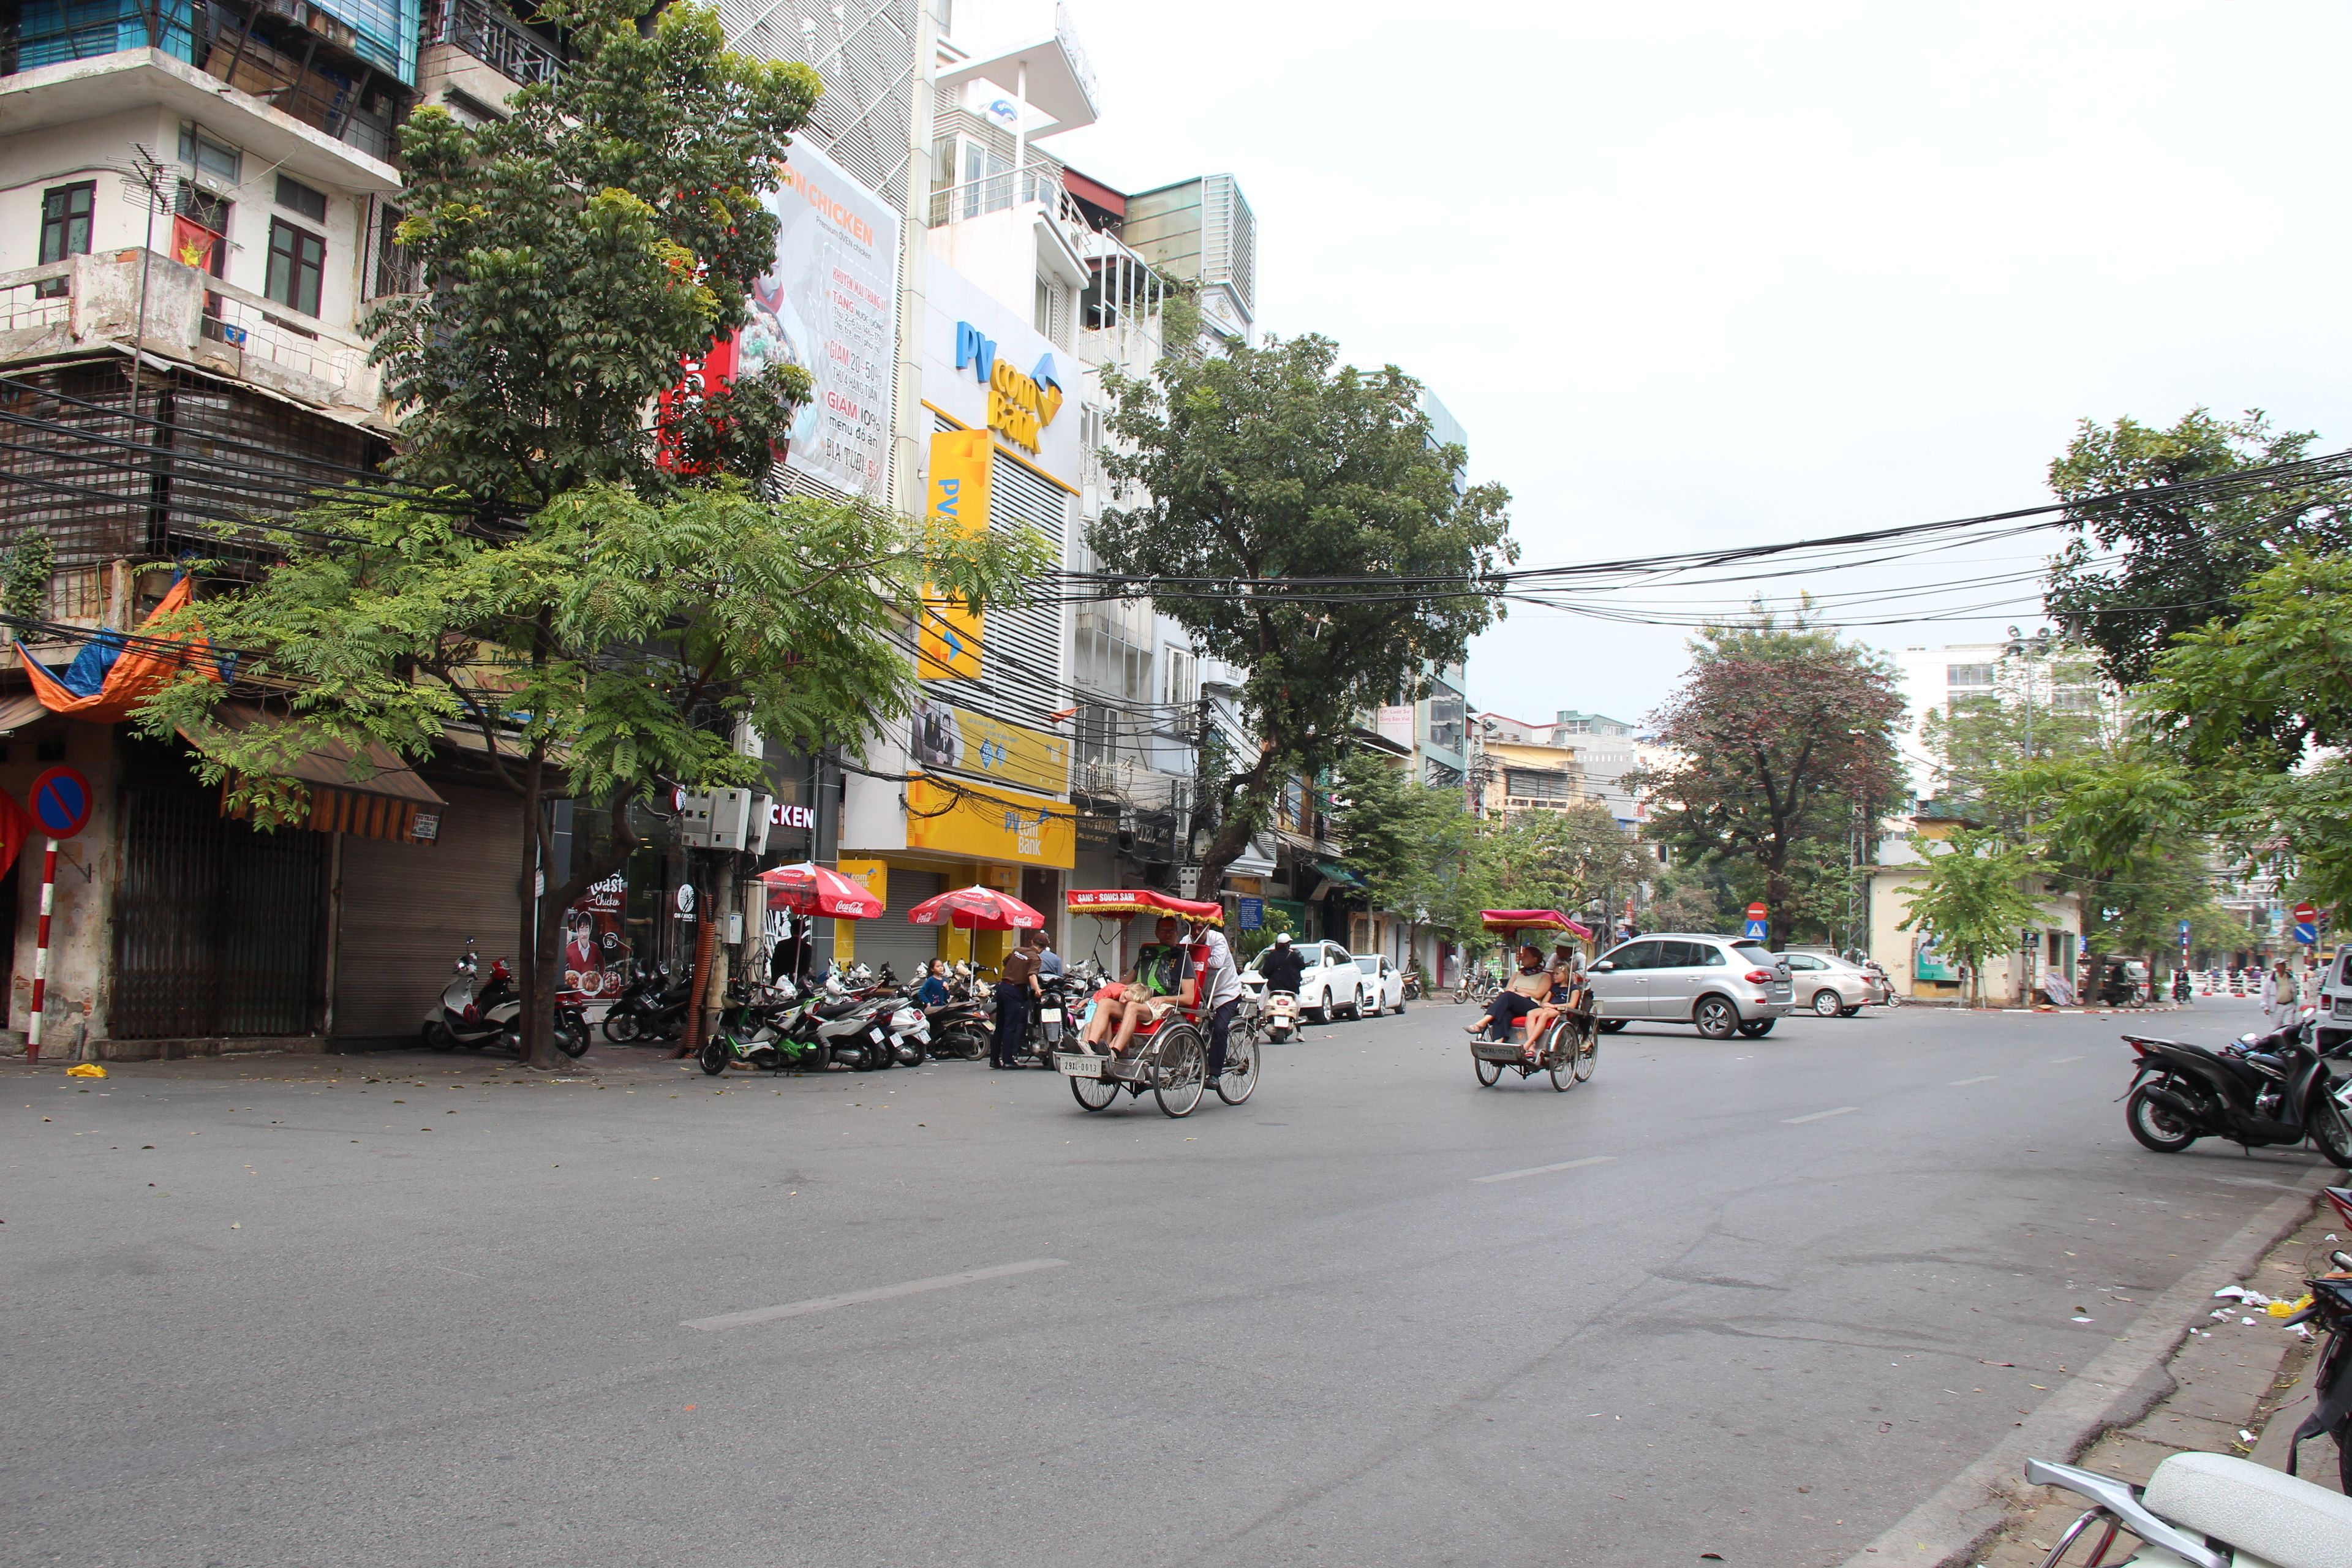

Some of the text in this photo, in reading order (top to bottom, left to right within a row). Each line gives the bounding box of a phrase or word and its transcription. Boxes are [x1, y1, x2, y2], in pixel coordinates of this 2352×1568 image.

[809, 184, 873, 247] CHICKEN
[815, 216, 872, 260] Premium OVEN chicken
[834, 320, 843, 331] cho
[830, 339, 849, 368] GIẢM
[844, 374, 848, 386] 4
[827, 391, 880, 432] GIẢM 10%
[987, 390, 1042, 454] Bank
[829, 416, 853, 436] menu
[868, 433, 878, 448] ăn
[826, 438, 841, 462] BIA
[770, 804, 813, 829] CKEN
[1018, 836, 1041, 856] Bank
[595, 892, 621, 907] Chicken
[1077, 894, 1094, 902] SANS
[1099, 893, 1118, 902] SOUCI
[1120, 892, 1136, 901] SARL
[1065, 1061, 1097, 1072] 29XL-0013
